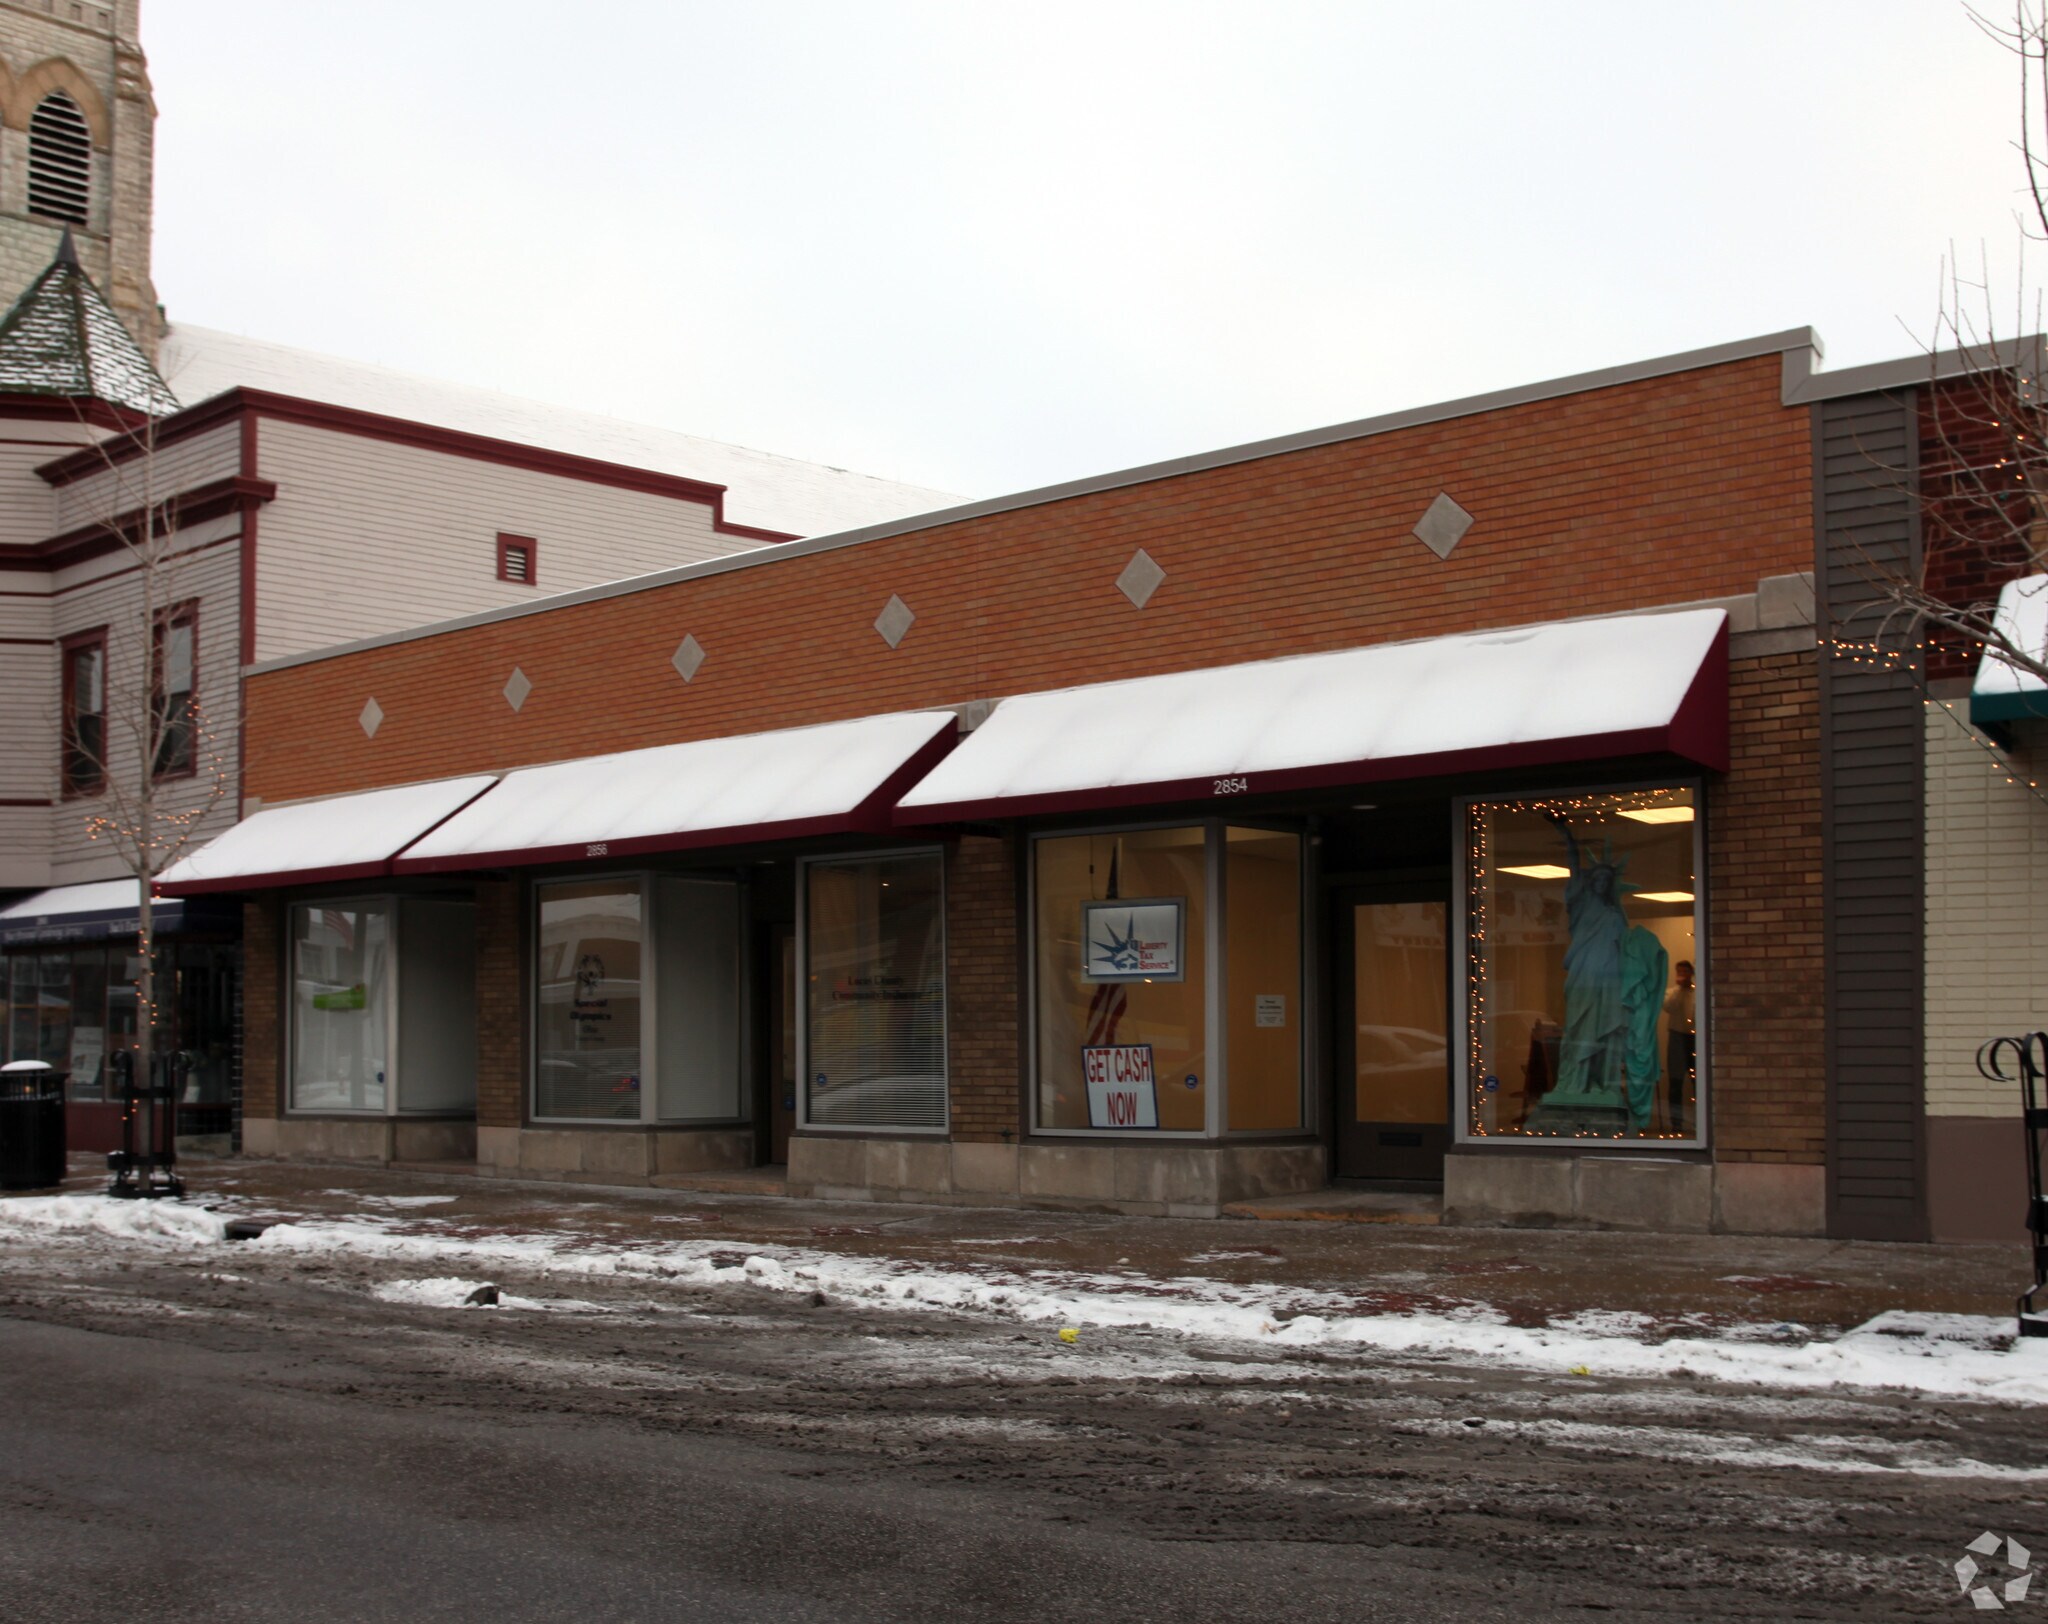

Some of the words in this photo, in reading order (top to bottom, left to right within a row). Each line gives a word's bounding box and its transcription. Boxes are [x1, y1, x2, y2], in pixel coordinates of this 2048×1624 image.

[1213, 777, 1248, 795] 2854
[585, 843, 608, 856] 2856
[1087, 1049, 1111, 1083] GET
[1114, 1047, 1150, 1083] CASH
[1107, 1092, 1136, 1125] NOW
